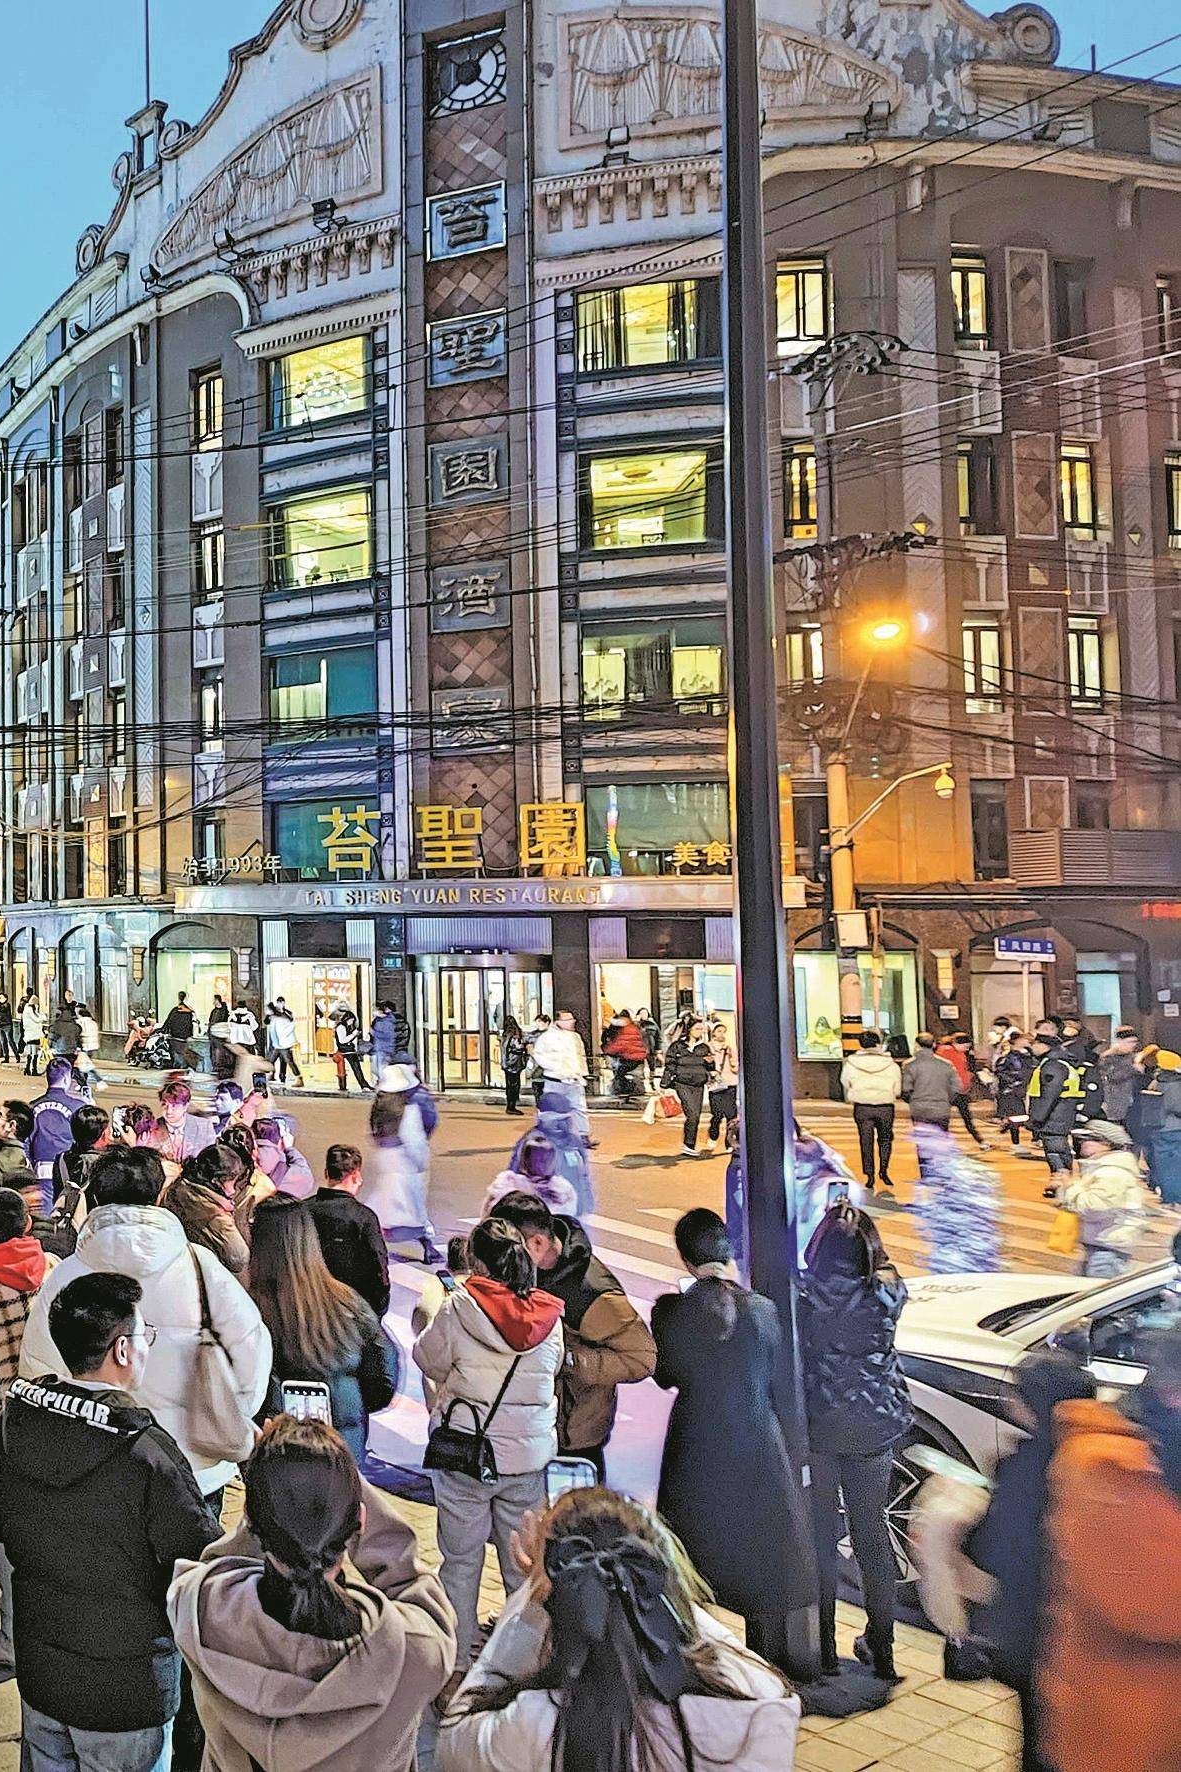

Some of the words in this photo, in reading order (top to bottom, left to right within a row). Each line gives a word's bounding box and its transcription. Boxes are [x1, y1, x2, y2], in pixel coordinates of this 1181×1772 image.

[317, 802, 586, 874] 苔聖園
[304, 889, 335, 906] TAI
[346, 889, 403, 906] SHENG
[412, 888, 460, 904] YUAN
[469, 887, 601, 904] RESTAURANT
[9, 1377, 111, 1425] CATERPILLAR
